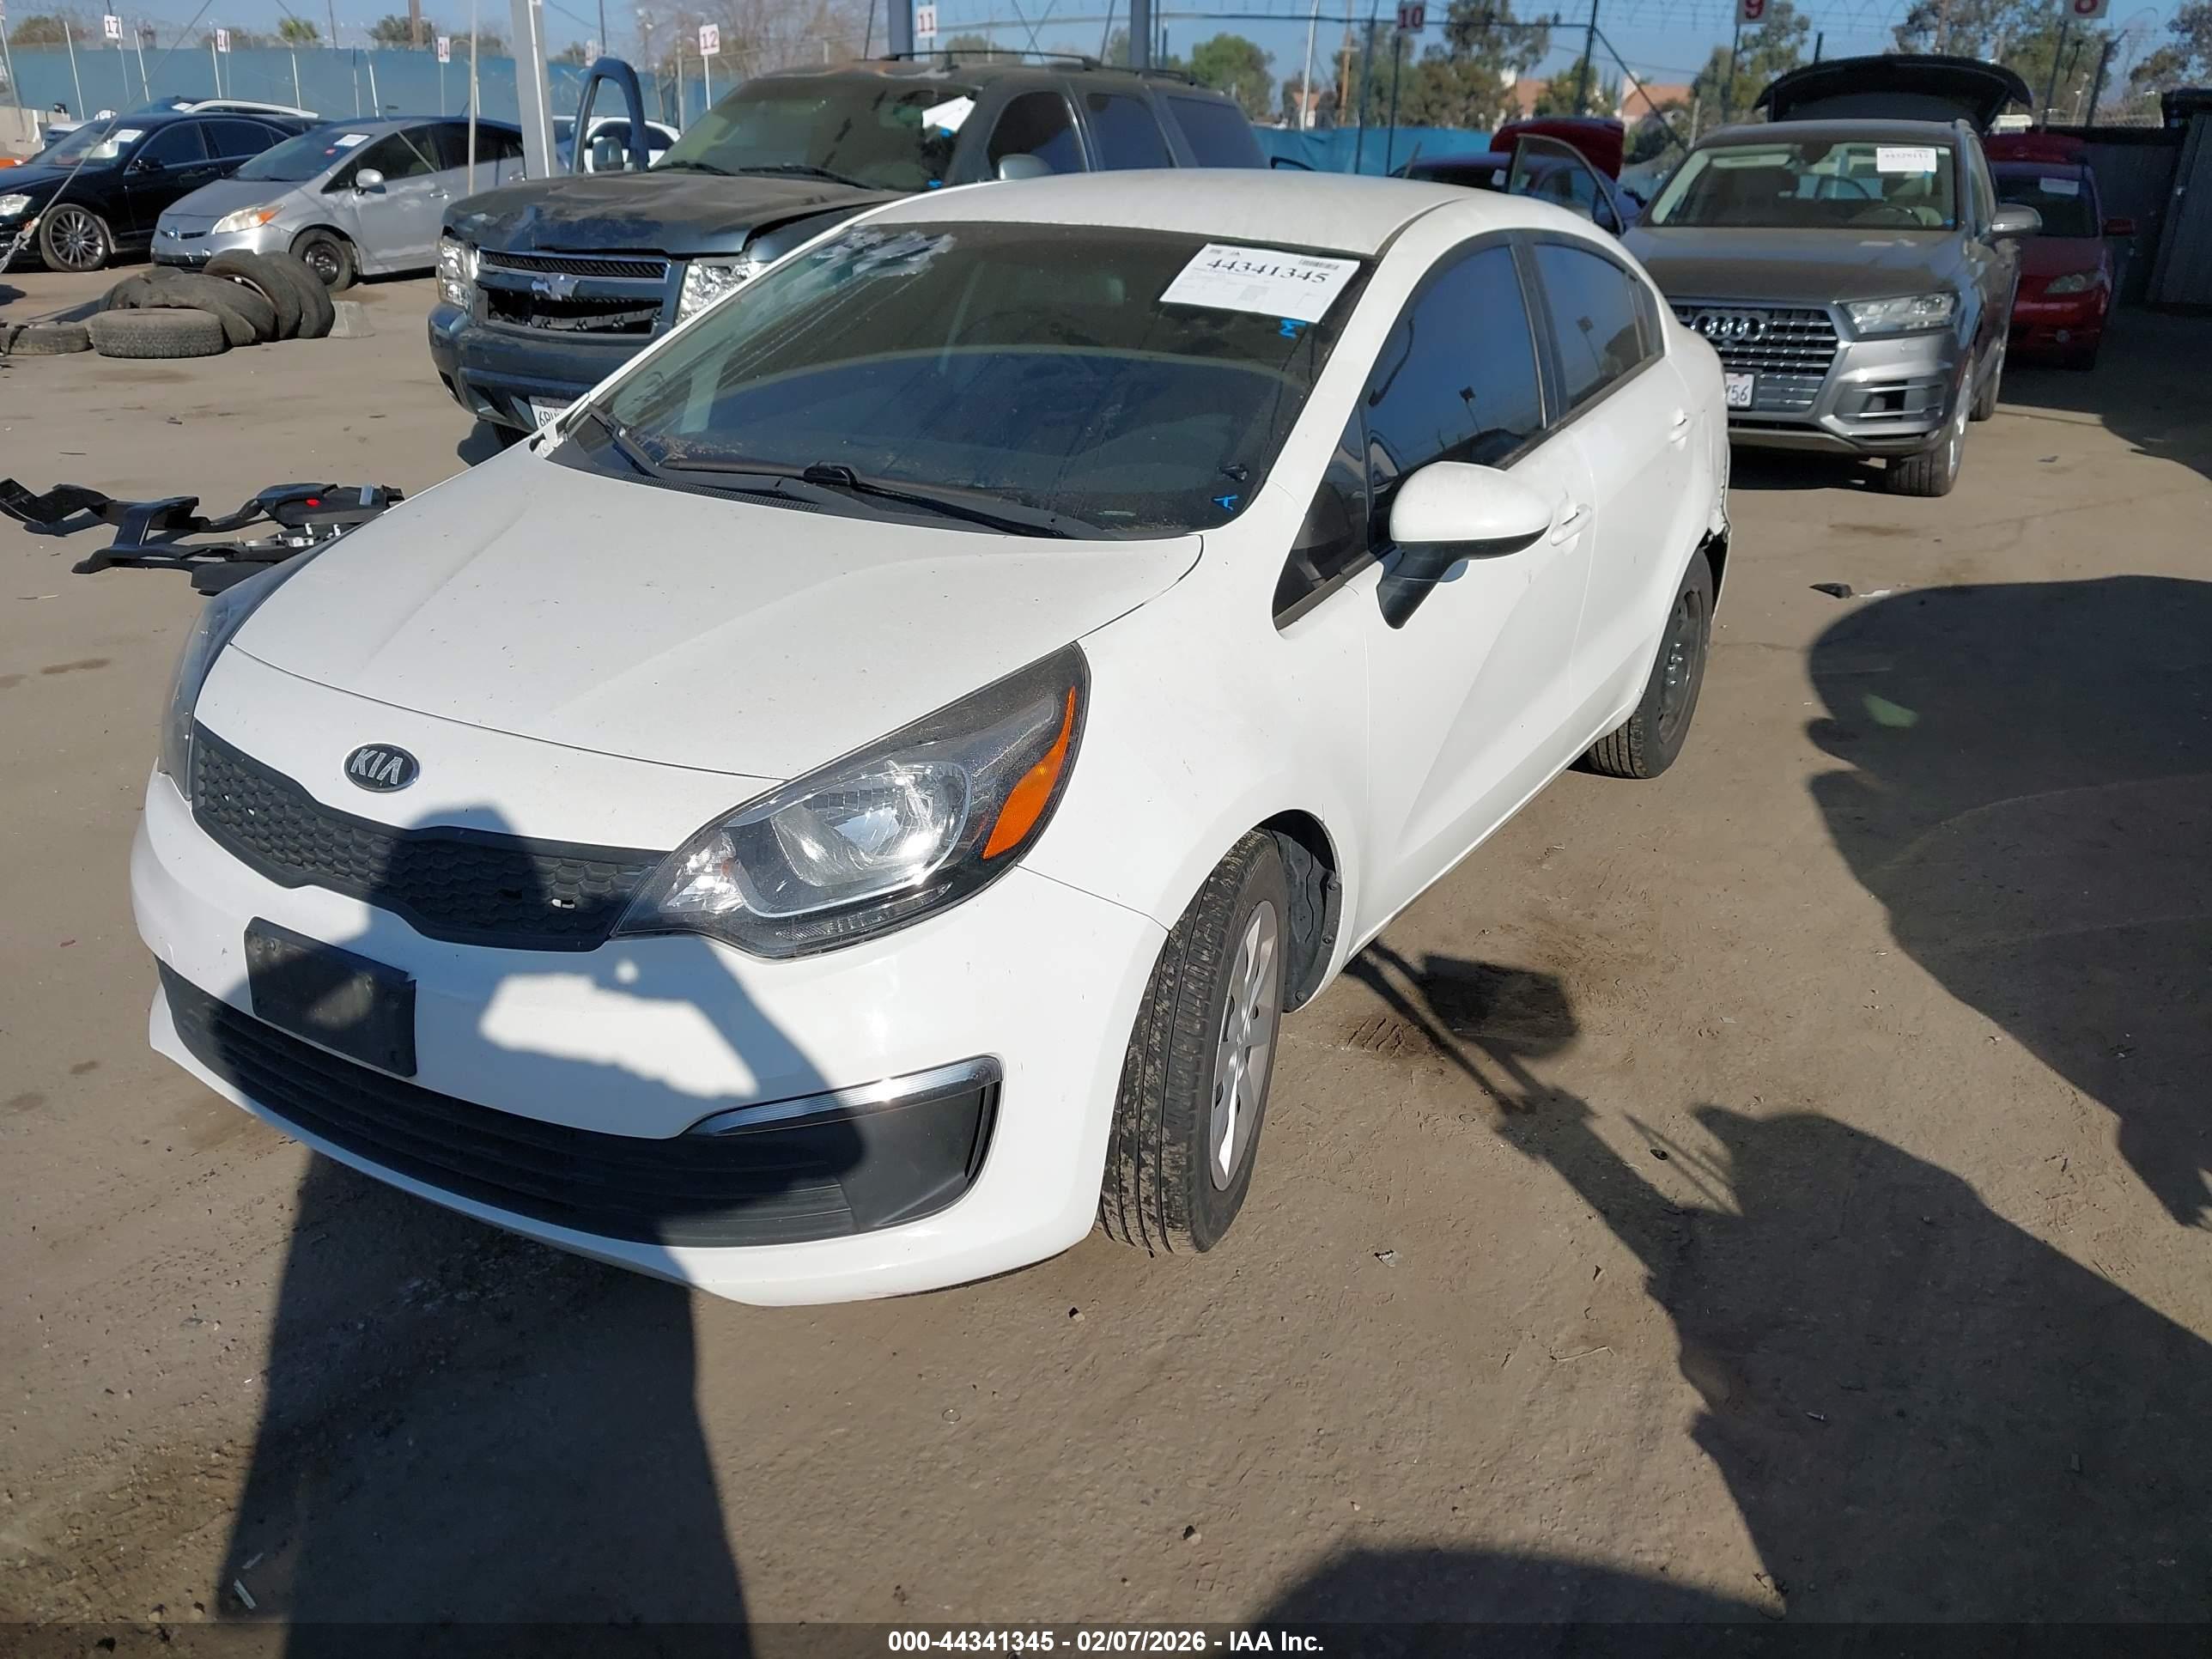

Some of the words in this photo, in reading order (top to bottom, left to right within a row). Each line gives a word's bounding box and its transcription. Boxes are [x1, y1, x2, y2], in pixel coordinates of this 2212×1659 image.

[919, 13, 934, 32] 11
[1400, 7, 1425, 28] 10
[702, 30, 718, 49] 12
[1206, 258, 1330, 283] 44341345
[349, 748, 404, 785] KIA
